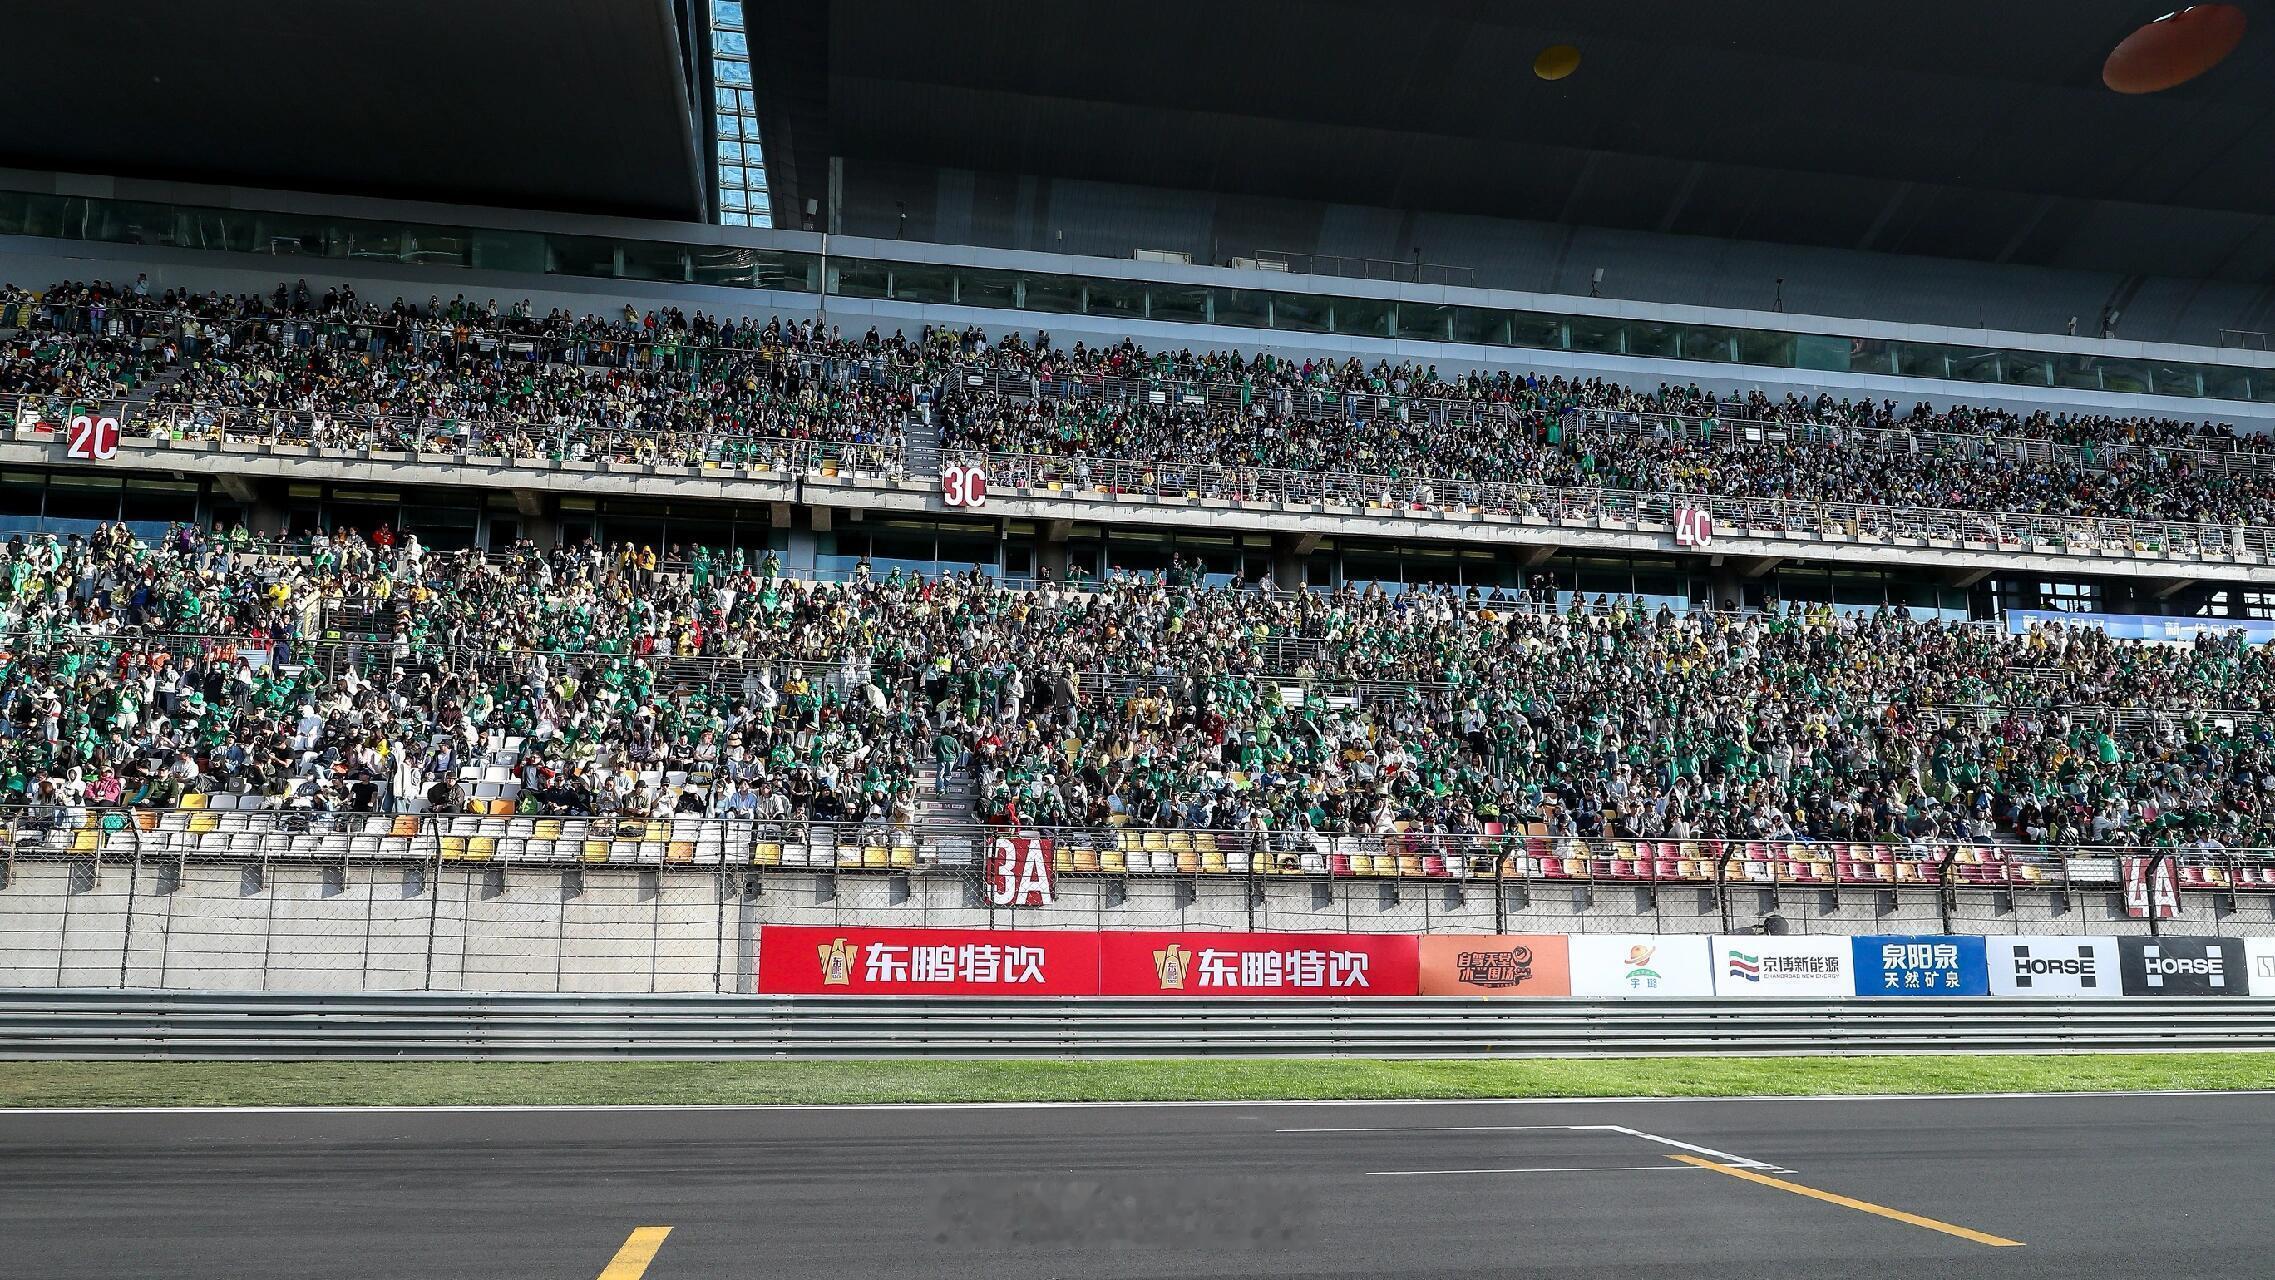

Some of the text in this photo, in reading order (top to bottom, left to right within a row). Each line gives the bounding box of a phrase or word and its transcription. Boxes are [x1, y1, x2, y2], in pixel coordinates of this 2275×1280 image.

[67, 415, 120, 460] 2C
[944, 466, 986, 507] 3C
[1676, 509, 1712, 547] 4C
[986, 838, 1054, 905] 3A
[2128, 857, 2180, 918] 4A
[865, 942, 1046, 983] 东鹏特饮
[1197, 948, 1370, 987] 东鹏特饮
[1457, 952, 1513, 967] 自驾天堂
[1763, 956, 1839, 973] 京博新能源
[1882, 943, 1959, 970] 泉阳泉
[2014, 959, 2096, 974] HORSE
[2144, 958, 2224, 974] HORSE
[1884, 971, 1961, 988] 天然矿泉
